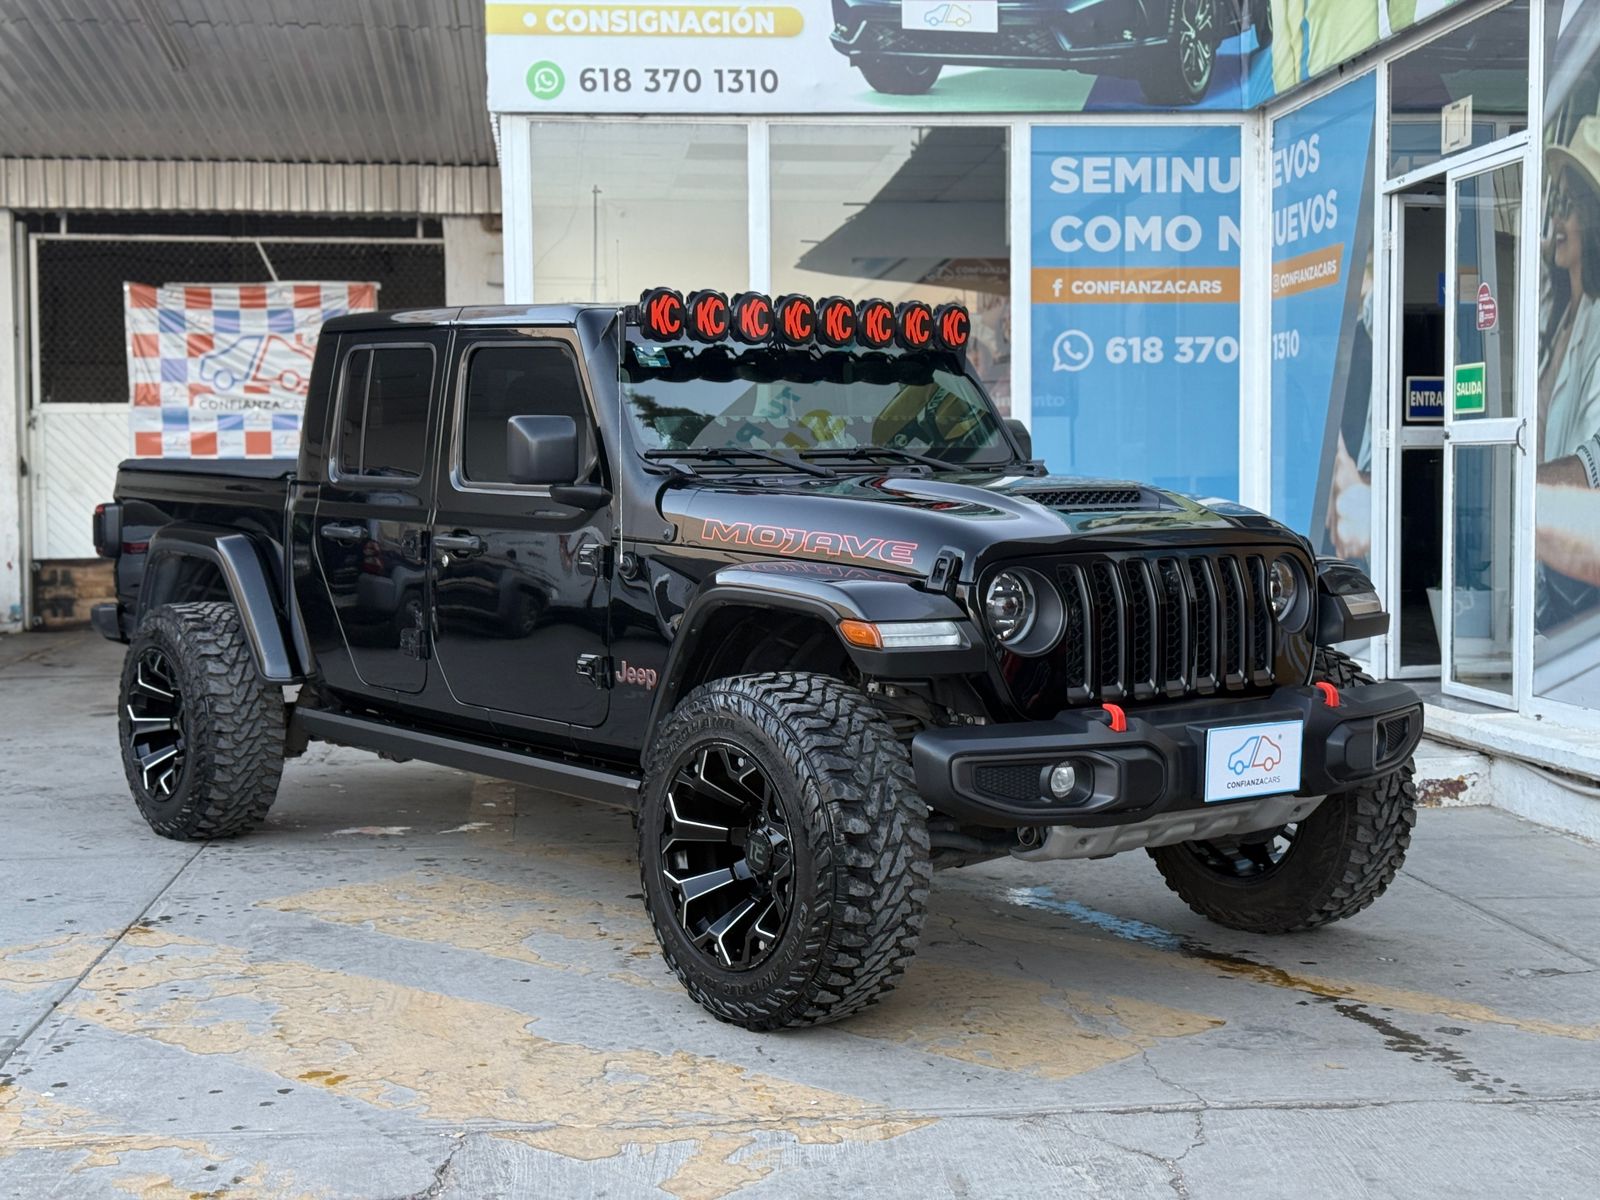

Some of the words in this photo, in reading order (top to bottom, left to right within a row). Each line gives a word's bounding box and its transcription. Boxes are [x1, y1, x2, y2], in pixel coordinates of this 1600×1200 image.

[545, 7, 775, 34] CONSIGNACIÓN
[579, 69, 632, 93] 618
[643, 69, 701, 93] 370
[713, 69, 779, 94] 1310
[1050, 156, 1240, 194] SEMINU
[1050, 215, 1202, 253] COMO
[1272, 189, 1338, 247] UEVOS
[1071, 280, 1222, 294] CONFIANZACARS
[1280, 259, 1337, 289] CONFIANZACARS
[651, 294, 680, 334] KC
[696, 296, 725, 336] KC
[741, 299, 769, 337] KC
[784, 301, 811, 340] KC
[826, 303, 852, 341] KC
[866, 305, 891, 341] KC
[905, 307, 930, 344] KC
[943, 309, 967, 346] KC
[1105, 337, 1163, 364] 618
[1173, 336, 1240, 364] 370
[1273, 329, 1299, 361] 1310
[1410, 391, 1444, 407] ENTRA
[1456, 381, 1482, 396] SALIDA
[701, 518, 918, 565] MOJAVE
[615, 660, 657, 690] Jeep
[1226, 776, 1281, 789] CONFIANZACARS
